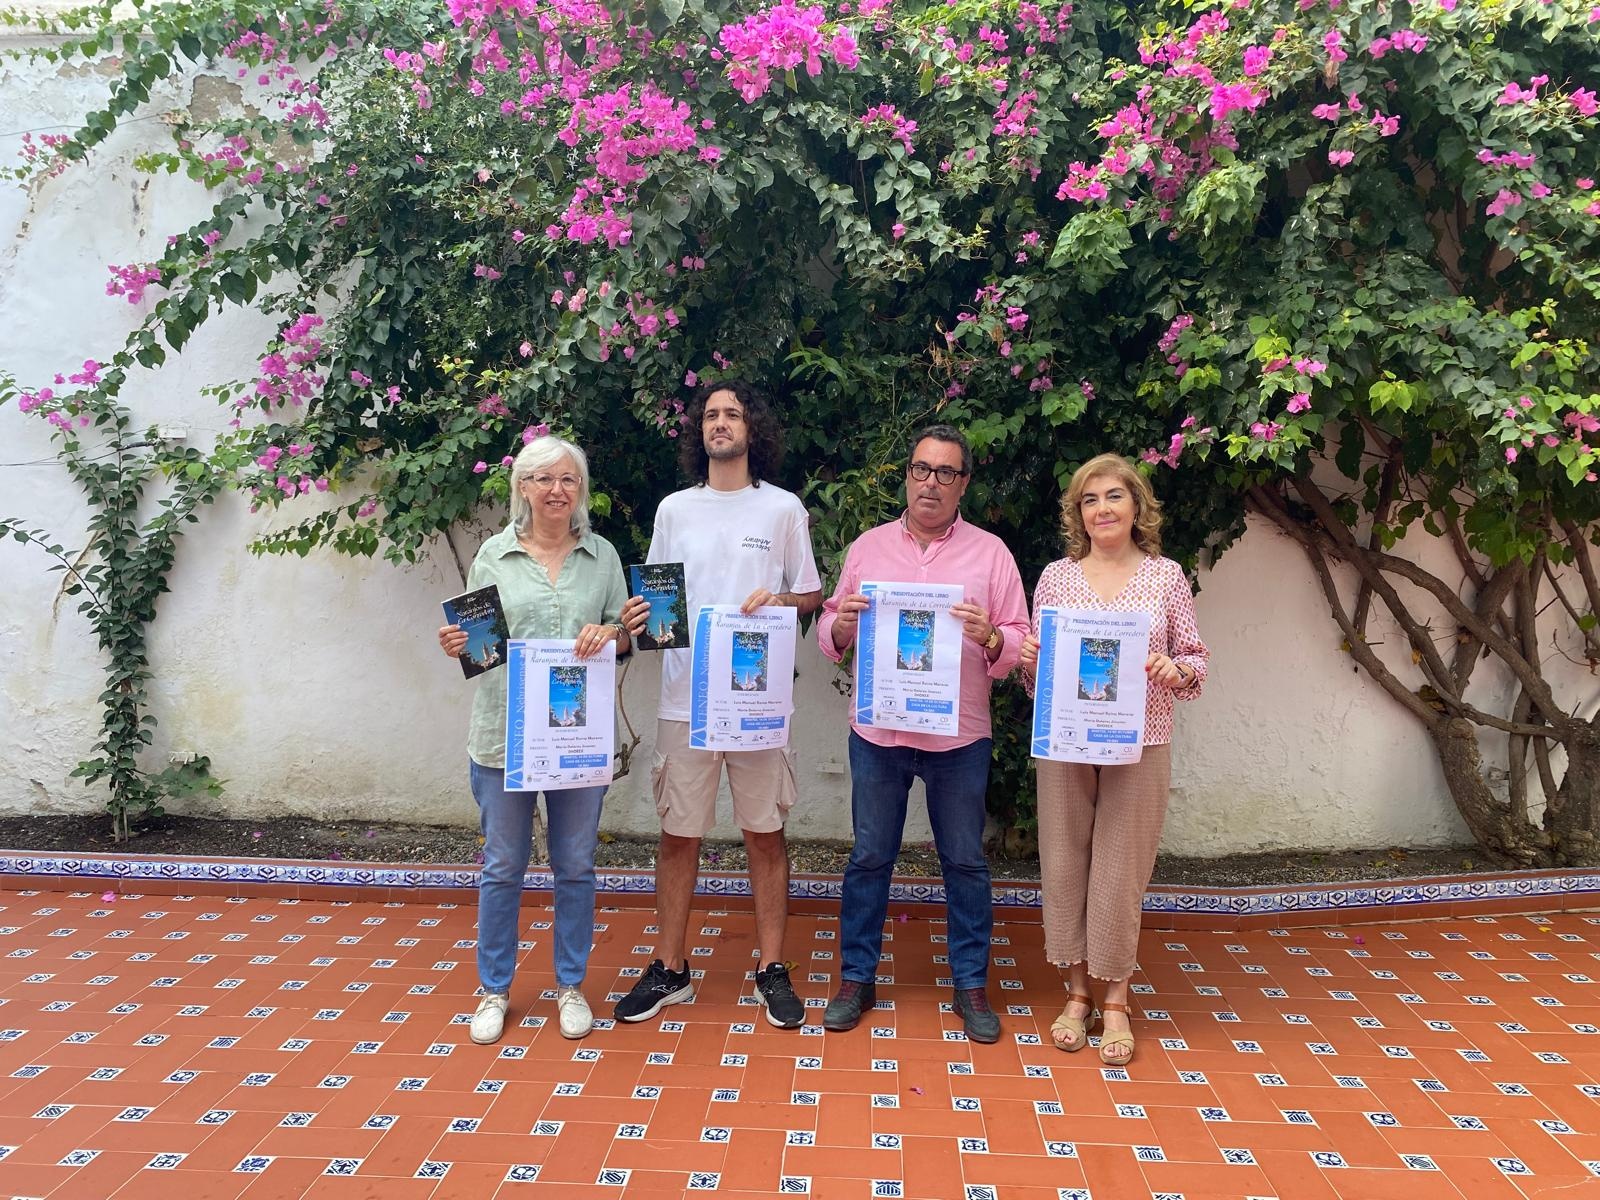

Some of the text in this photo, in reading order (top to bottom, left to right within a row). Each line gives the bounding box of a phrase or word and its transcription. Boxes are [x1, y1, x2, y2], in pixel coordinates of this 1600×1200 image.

[742, 543, 771, 552] Selection
[642, 576, 668, 587] Naranjos
[891, 590, 925, 598] PRESENTACIÓN
[881, 599, 908, 609] Naranjos
[457, 604, 483, 617] Naranjos
[716, 621, 741, 630] Naranjos
[763, 623, 792, 631] Corredera
[1072, 618, 1110, 626] PRESENTACIÓN
[1061, 624, 1146, 638] Naranjos de La Corredera
[531, 656, 558, 665] Naranjos
[857, 659, 874, 722] ATENEO
[691, 681, 708, 744] ATENEO
[1033, 688, 1053, 754] ATENEO
[506, 719, 524, 785] ATENEO
